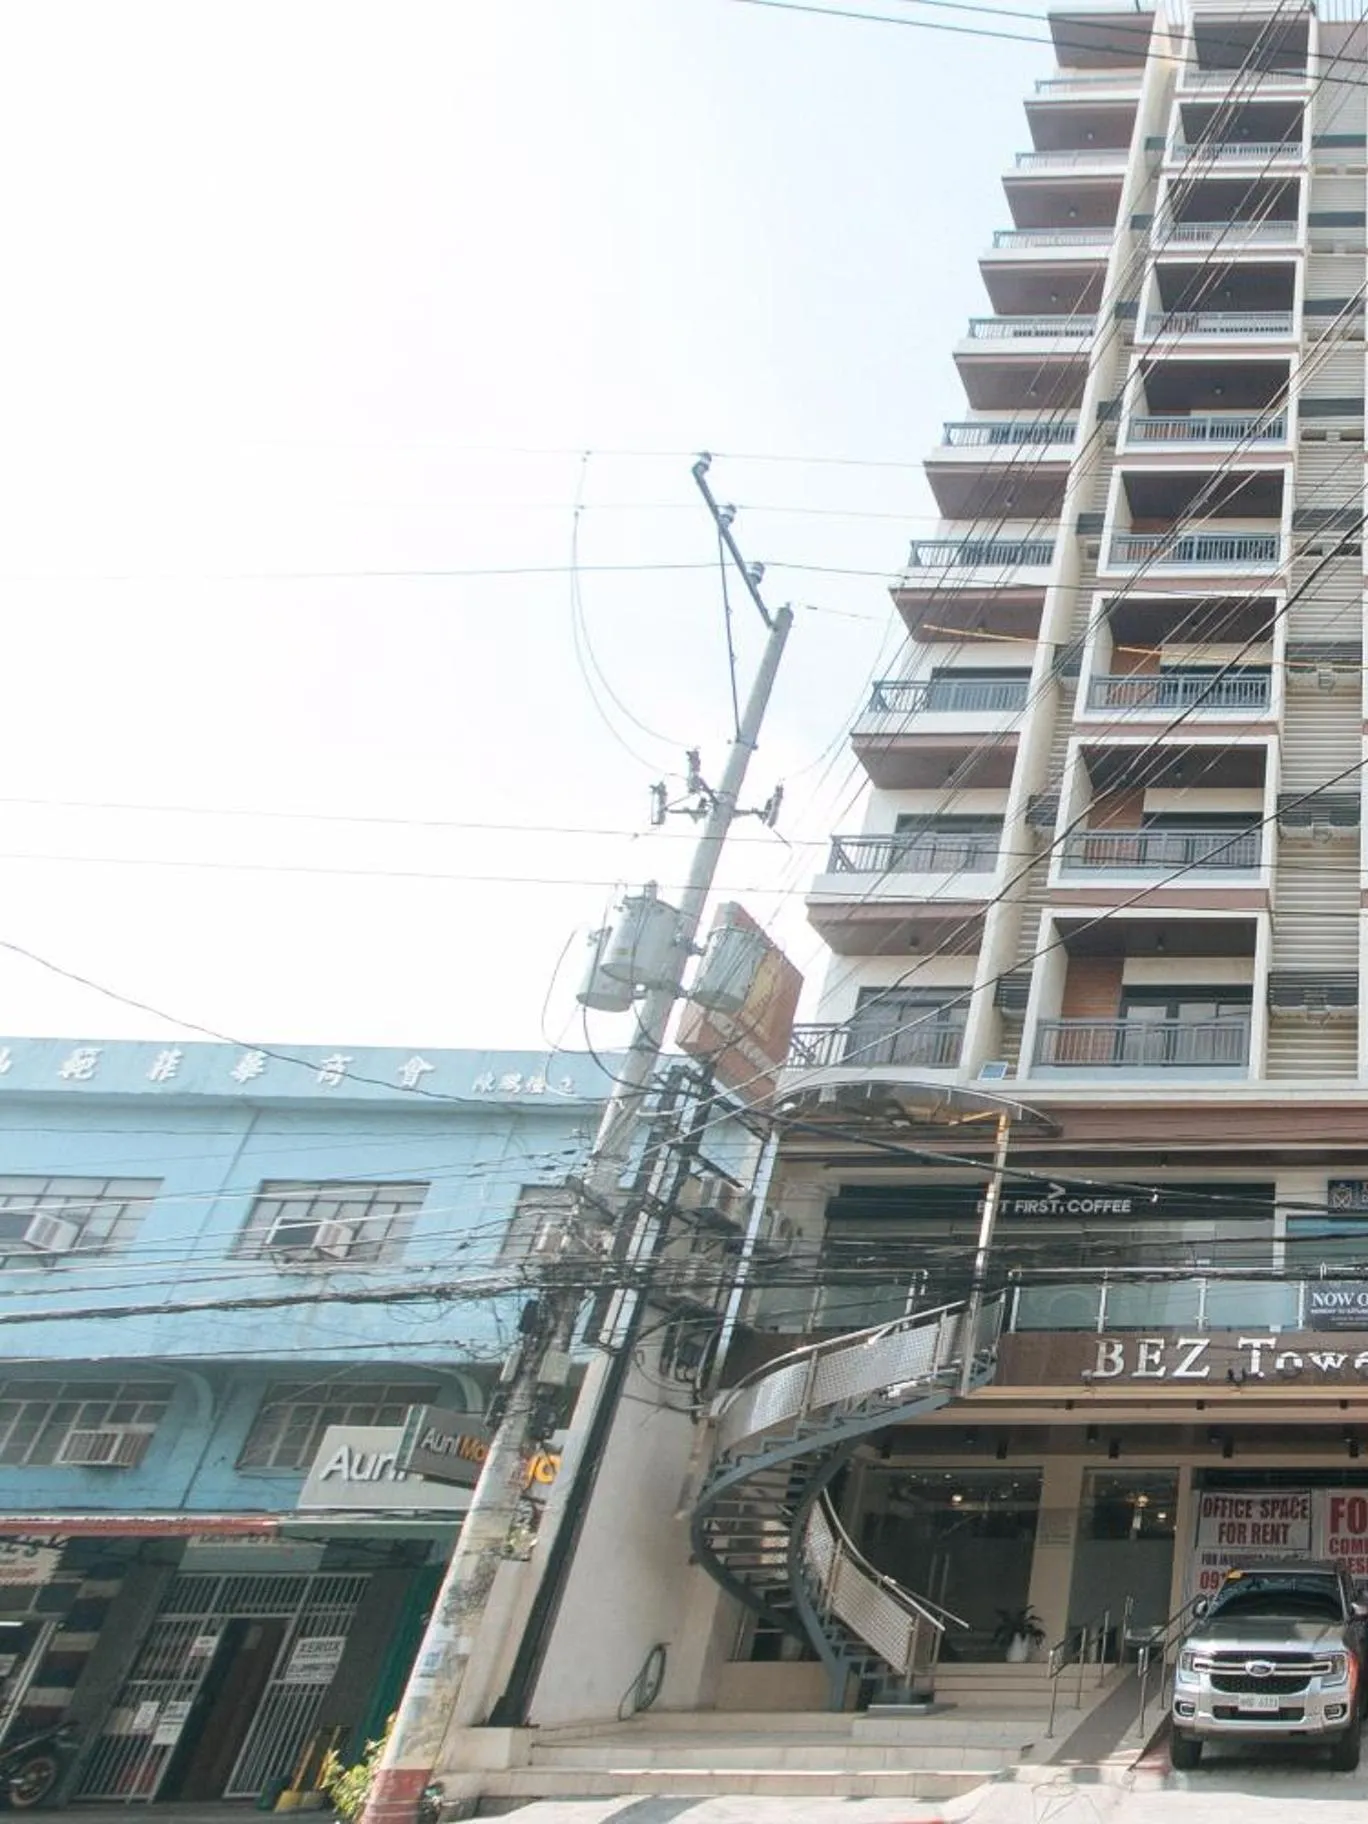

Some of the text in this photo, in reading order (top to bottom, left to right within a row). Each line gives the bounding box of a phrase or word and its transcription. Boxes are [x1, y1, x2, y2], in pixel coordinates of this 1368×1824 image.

[977, 1199, 1010, 1213] BT
[1067, 1199, 1132, 1214] COFFEE
[1311, 1292, 1355, 1308] NOW
[1091, 1337, 1211, 1379] BEZ
[319, 1443, 424, 1482] Aun
[1203, 1497, 1309, 1519] OFFICE SPACE
[1218, 1522, 1290, 1544] FOR RENT
